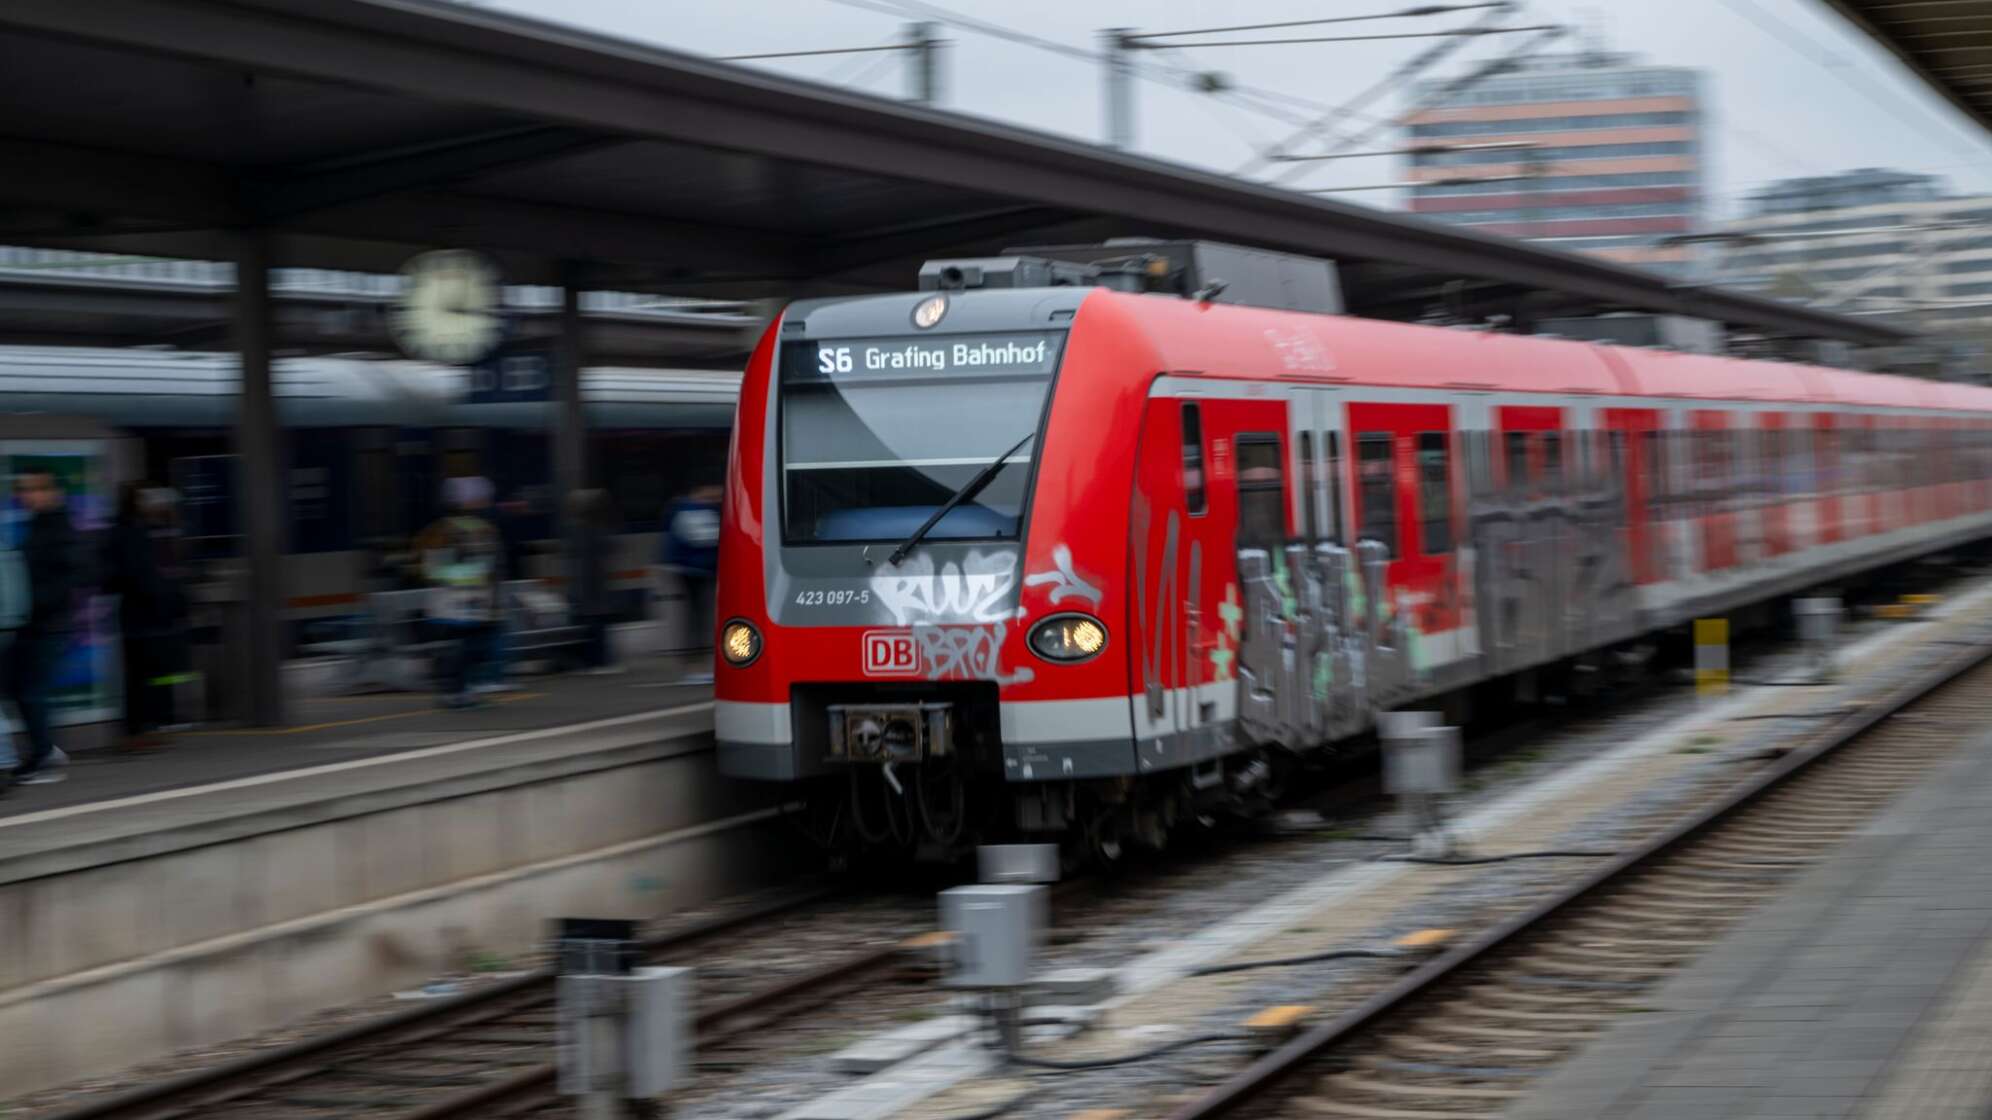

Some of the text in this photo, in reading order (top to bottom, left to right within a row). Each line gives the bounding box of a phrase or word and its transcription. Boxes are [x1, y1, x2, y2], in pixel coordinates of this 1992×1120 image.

[818, 341, 1046, 373] S6 Grafing Bahnhof
[795, 590, 870, 605] 423 097-5
[871, 639, 913, 667] DB
